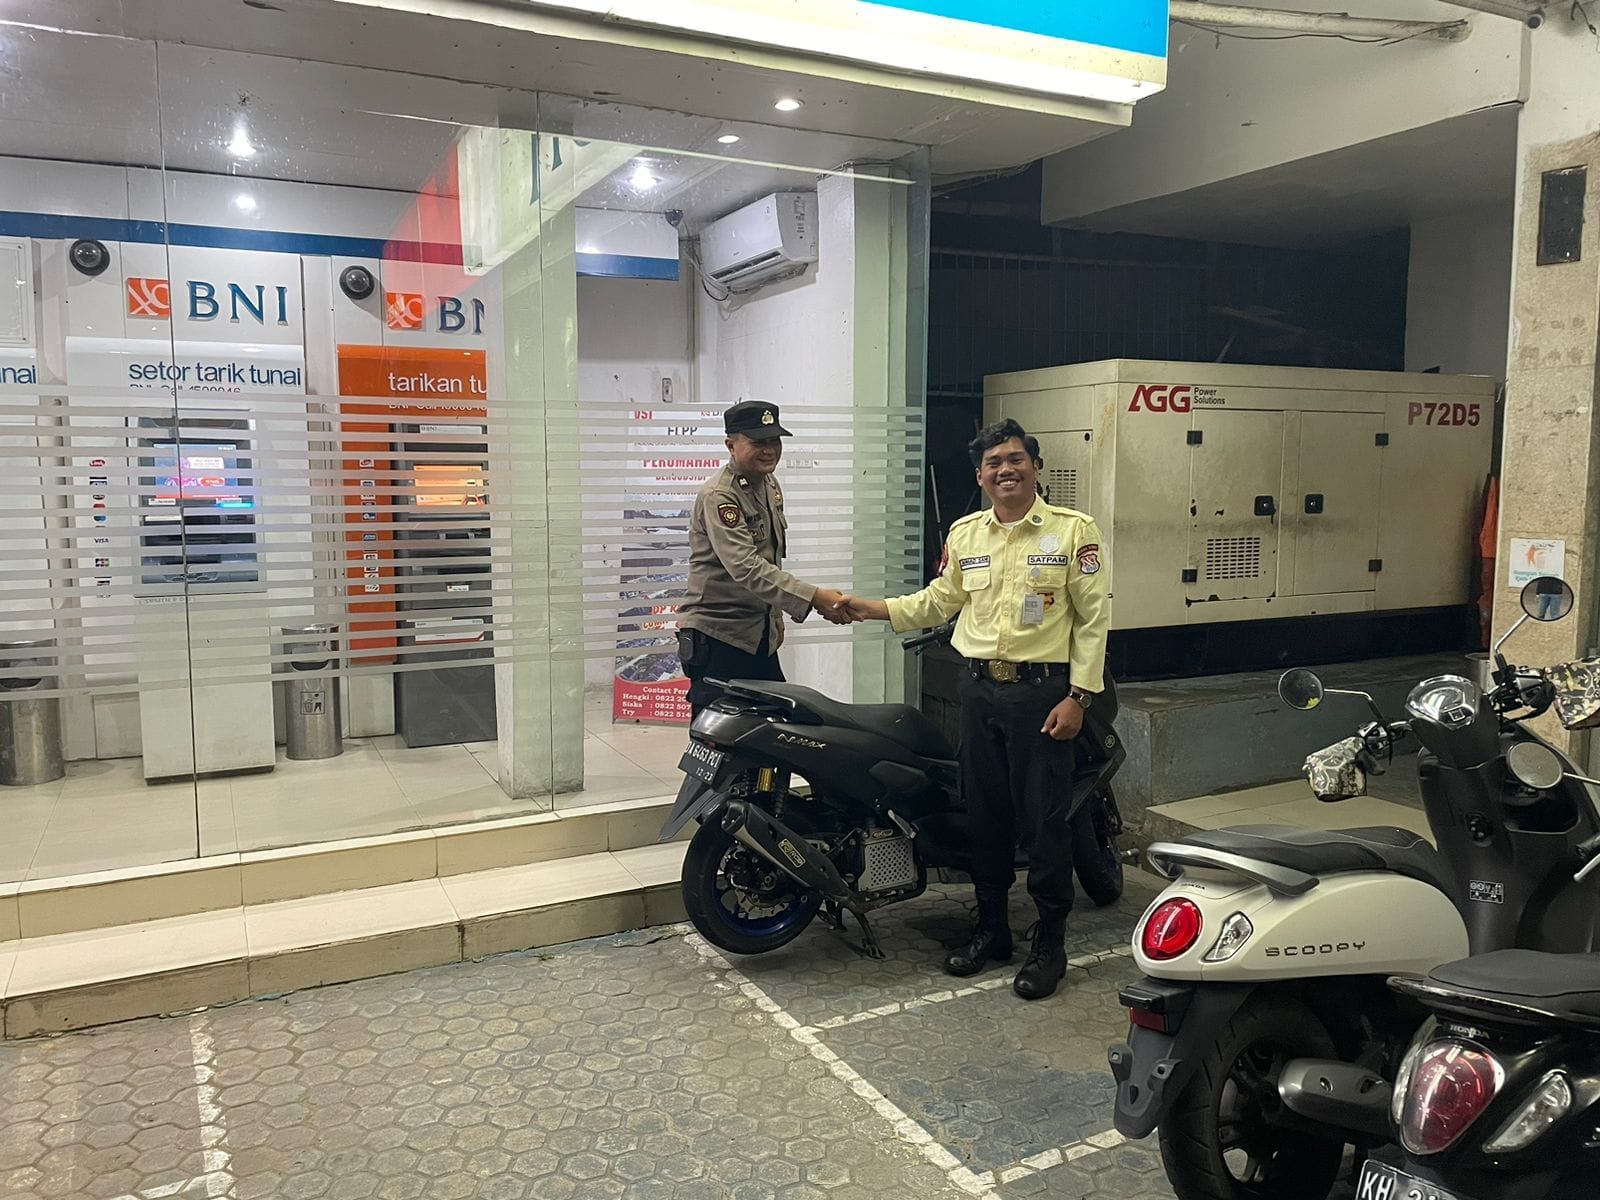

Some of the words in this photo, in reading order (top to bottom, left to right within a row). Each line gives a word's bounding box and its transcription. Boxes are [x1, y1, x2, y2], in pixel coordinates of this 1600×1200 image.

[185, 279, 289, 326] BNI
[0, 364, 37, 384] nai
[128, 361, 191, 382] setor
[195, 362, 246, 383] tarik
[248, 365, 301, 386] tunai
[387, 372, 464, 393] tarikan
[1127, 384, 1191, 413] AGG
[1193, 387, 1217, 396] Power
[1193, 395, 1226, 405] Solutions
[1408, 402, 1481, 427] P72D5
[1029, 556, 1066, 564] SATPAM
[622, 693, 650, 702] Hengki
[642, 686, 671, 694] Contact
[622, 709, 636, 717] Try
[654, 702, 674, 710] 0822
[1265, 941, 1366, 957] SCOOPY
[1361, 1171, 1394, 1200] KH
